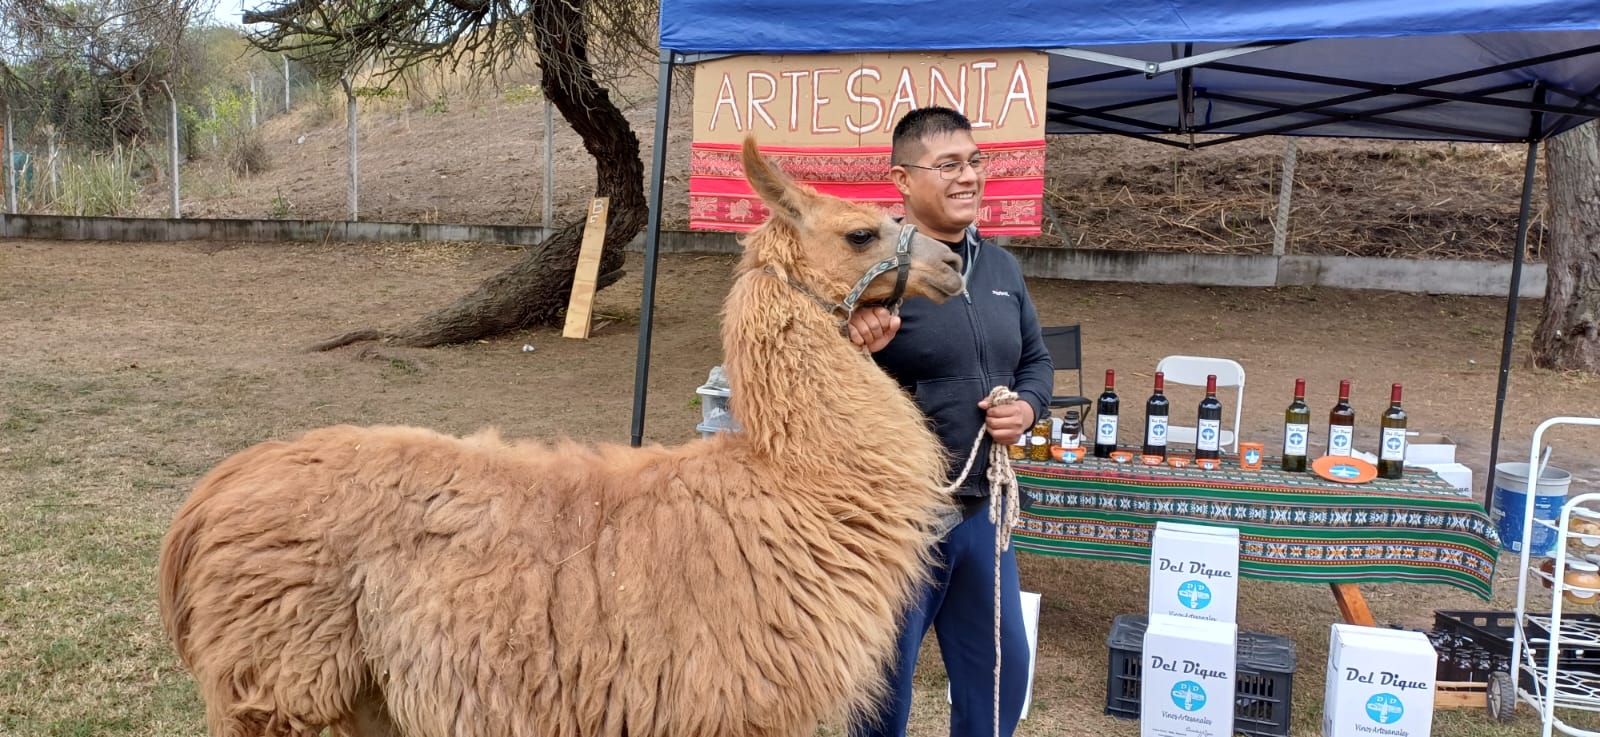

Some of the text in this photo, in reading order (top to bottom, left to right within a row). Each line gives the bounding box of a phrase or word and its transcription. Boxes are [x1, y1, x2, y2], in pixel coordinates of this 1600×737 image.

[708, 58, 1039, 135] ARTESANIA
[1159, 558, 1232, 578] Del Dique
[1151, 655, 1228, 679] Del Dique
[1346, 667, 1428, 691] Del Dique
